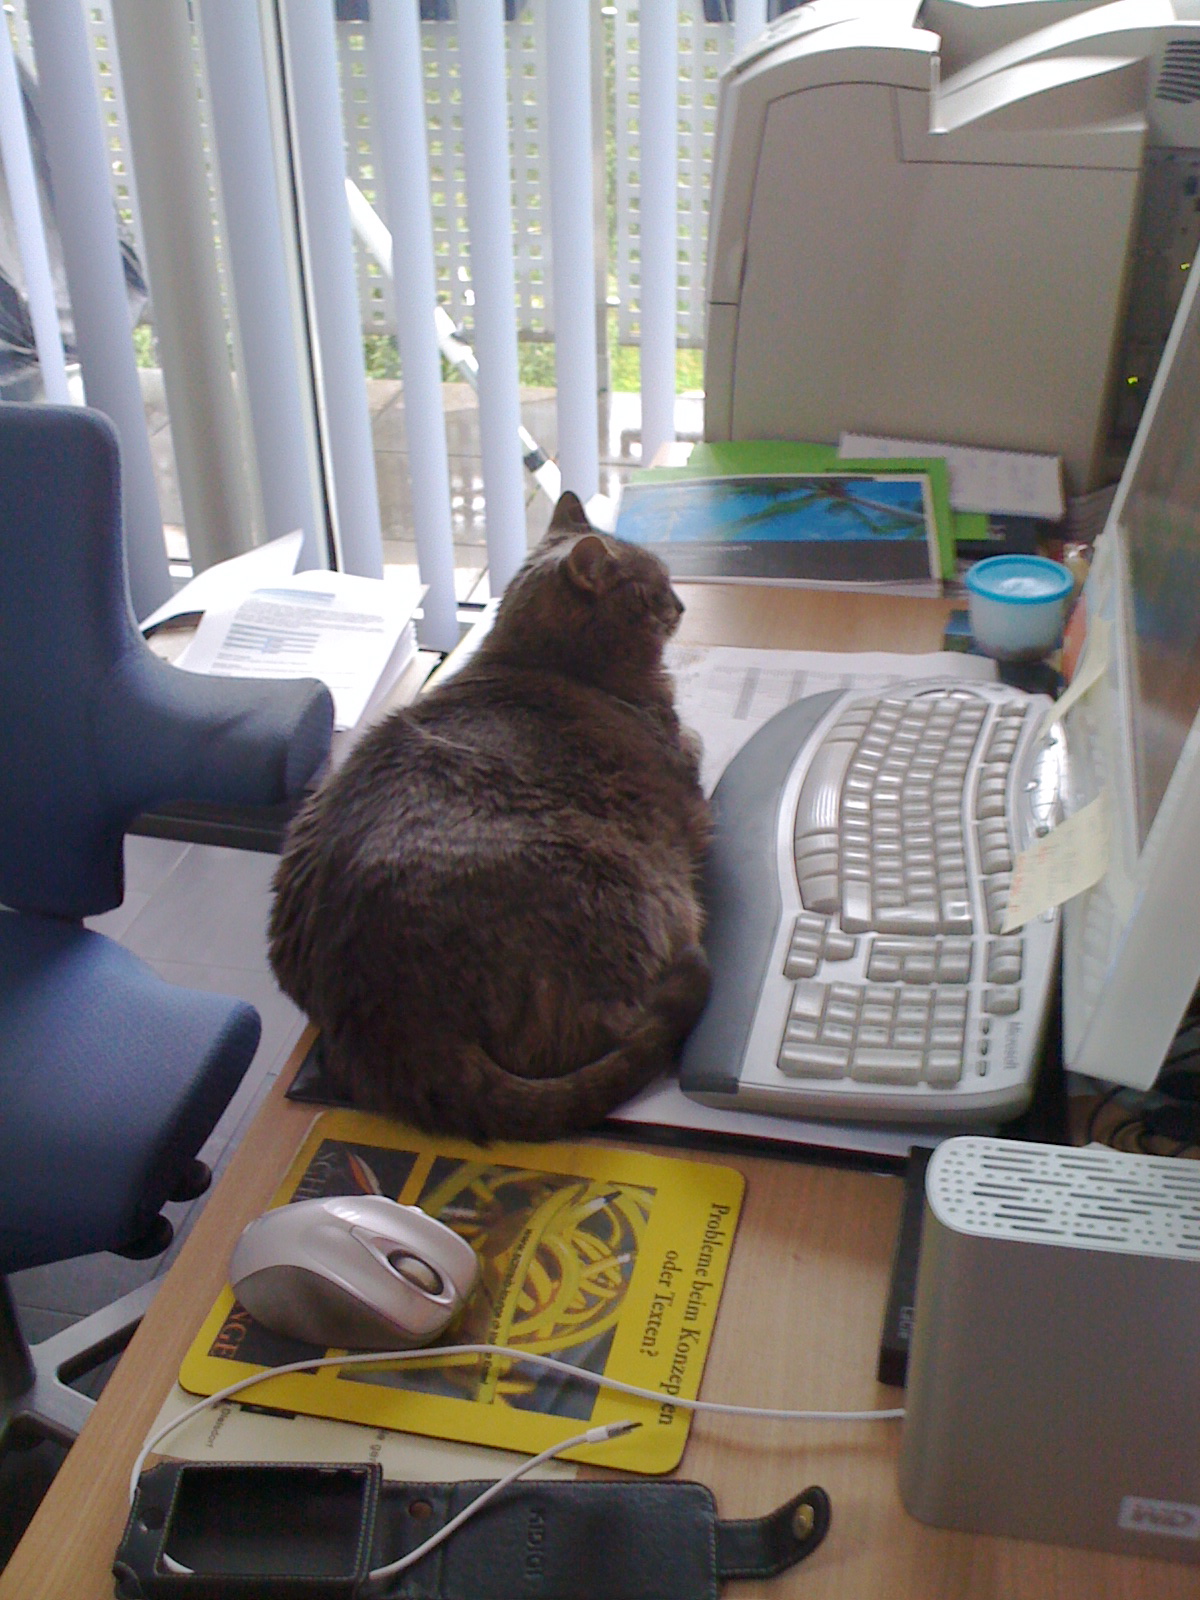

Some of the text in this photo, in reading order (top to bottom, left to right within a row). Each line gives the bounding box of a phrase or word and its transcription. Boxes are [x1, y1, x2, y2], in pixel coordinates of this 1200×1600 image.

[640, 1250, 683, 1357] oder Texten?
[658, 1203, 731, 1425] Probleme beim Konzepen
